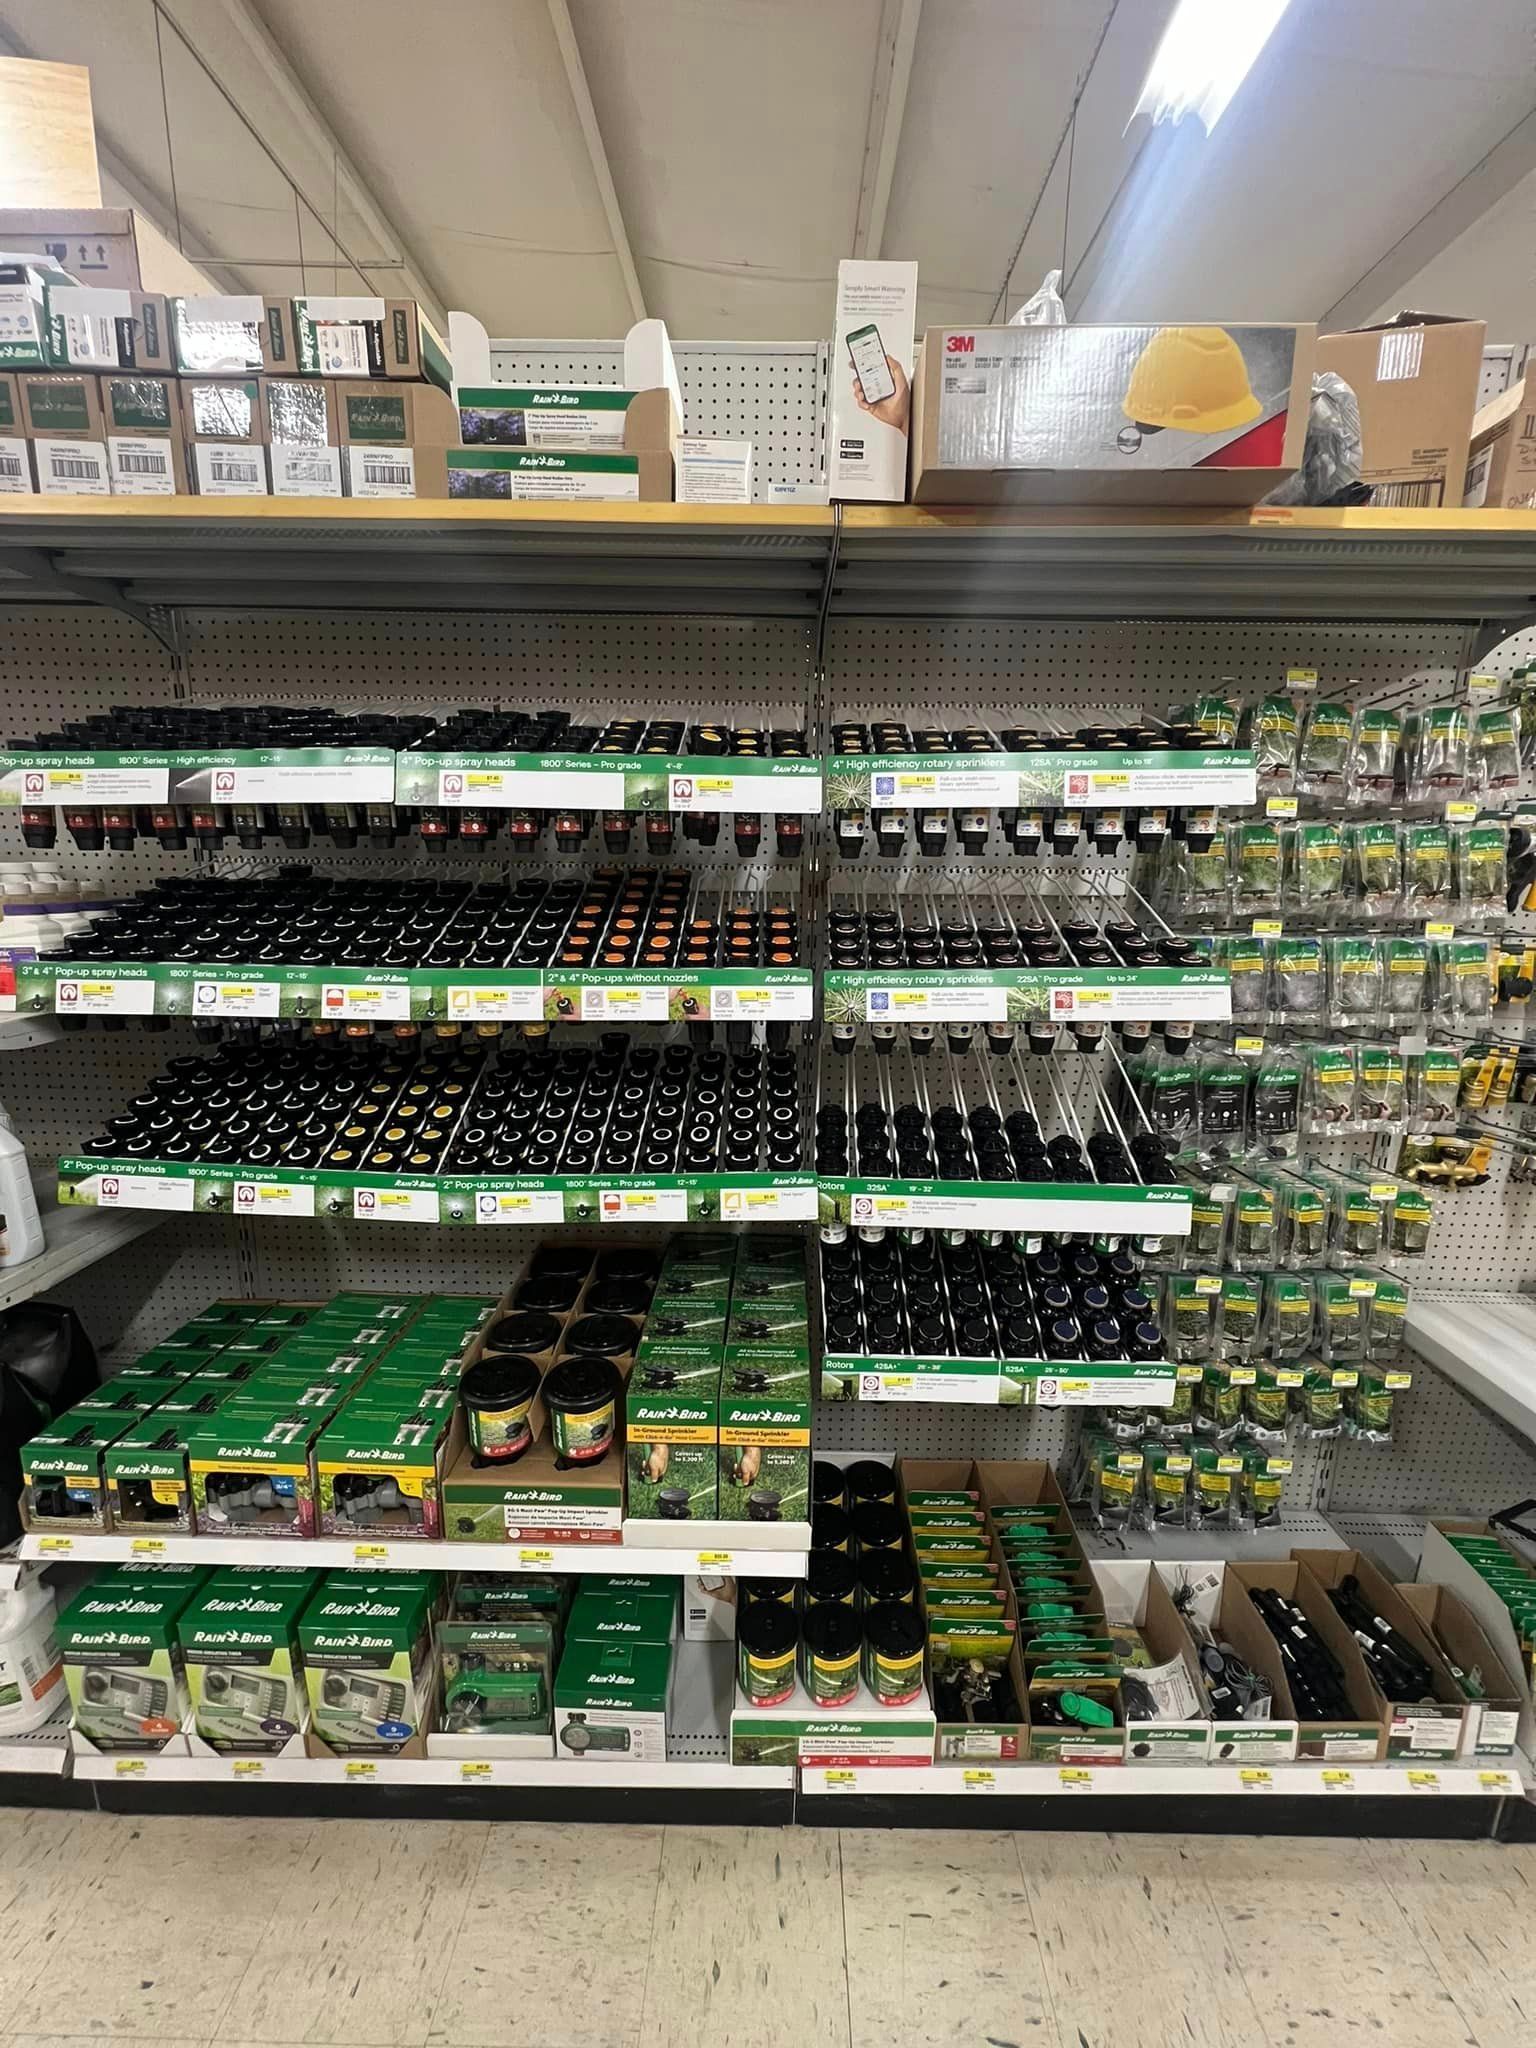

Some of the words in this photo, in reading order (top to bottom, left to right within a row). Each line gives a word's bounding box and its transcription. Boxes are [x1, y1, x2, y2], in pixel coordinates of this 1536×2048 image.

[946, 336, 975, 352] 3M
[533, 395, 552, 404] RAIN
[559, 396, 580, 405] BIRD
[520, 457, 539, 466] RAIN
[546, 458, 566, 467] BIRD
[36, 757, 63, 767] spray
[66, 755, 95, 765] heads
[143, 757, 168, 765] Series
[176, 756, 195, 766] High
[197, 755, 236, 766] efficiency
[344, 755, 364, 763] RAIN
[370, 755, 391, 763] BIRD
[415, 757, 452, 767] Pop-up
[455, 758, 482, 768] spray
[485, 758, 516, 767] heads
[565, 760, 592, 768] Series
[846, 759, 870, 771] High
[872, 758, 921, 771] efficiency
[923, 758, 953, 770] rotary
[956, 757, 1006, 768] sprinklers
[1056, 758, 1072, 767] Pro
[1074, 759, 1098, 768] grade
[1122, 758, 1132, 766] Up
[1203, 757, 1224, 765] RAIN
[1231, 757, 1251, 765] BIRD
[601, 761, 615, 769] Pro
[617, 762, 642, 770] grade
[772, 765, 793, 773] RAIN
[799, 765, 818, 774] BIRD
[55, 967, 89, 977] Pop-up
[91, 968, 117, 978] spray
[119, 968, 147, 977] heads
[192, 970, 217, 978] Series
[226, 971, 238, 979] Pro
[239, 972, 264, 980] grade
[582, 974, 623, 984] Pop-ups
[626, 973, 661, 983] without
[663, 974, 699, 982] nozzles
[765, 974, 784, 983] RAIN
[791, 975, 809, 983] BIRD
[843, 976, 865, 986] High
[867, 975, 913, 987] efficiency
[915, 975, 944, 986] rotary
[947, 975, 994, 985] sprinklers
[1043, 975, 1057, 983] Pro
[1059, 976, 1084, 985] grade
[1107, 975, 1117, 983] Up
[75, 1161, 109, 1172] Pop-up
[111, 1163, 136, 1174] spray
[138, 1164, 166, 1174] heads
[211, 1169, 234, 1178] Series
[255, 1173, 278, 1181] grade
[455, 1181, 488, 1191] Pop-up
[490, 1181, 516, 1191] spray
[517, 1180, 545, 1189] heads
[588, 1180, 612, 1188] Series
[634, 1179, 656, 1188] grade
[826, 1360, 854, 1369] Rotors
[637, 1408, 668, 1419] RAIN
[678, 1409, 708, 1420] BIRD
[729, 1410, 760, 1421] RAIN
[771, 1411, 801, 1423] BIRD
[761, 1430, 790, 1438] Sprinkler
[216, 1447, 242, 1457] RAIN
[252, 1448, 277, 1458] BIRD
[346, 1449, 371, 1459] RAIN
[381, 1450, 406, 1460] BIRD
[30, 1460, 56, 1470] RAIN
[64, 1461, 88, 1471] BIRD
[115, 1464, 141, 1474] RAIN
[150, 1465, 175, 1475] BIRD
[504, 1491, 529, 1500] RAIN
[538, 1492, 563, 1501] BIRD
[80, 1601, 118, 1612] RAIN
[129, 1602, 163, 1613] BIRD
[202, 1600, 237, 1611] RAIN
[251, 1601, 284, 1612] BIRD
[320, 1603, 356, 1615] RAIN
[367, 1604, 400, 1616] BIRD
[71, 1633, 104, 1644] RAIN
[118, 1633, 151, 1645] BIRD
[194, 1631, 228, 1643] RAIN
[242, 1633, 273, 1644] BIRD
[470, 1631, 491, 1640] RAIN
[497, 1632, 517, 1640] BIRD
[314, 1636, 347, 1647] RAIN
[360, 1636, 393, 1648] BIRD
[587, 1674, 608, 1684] RAIN
[614, 1676, 635, 1685] BIRD
